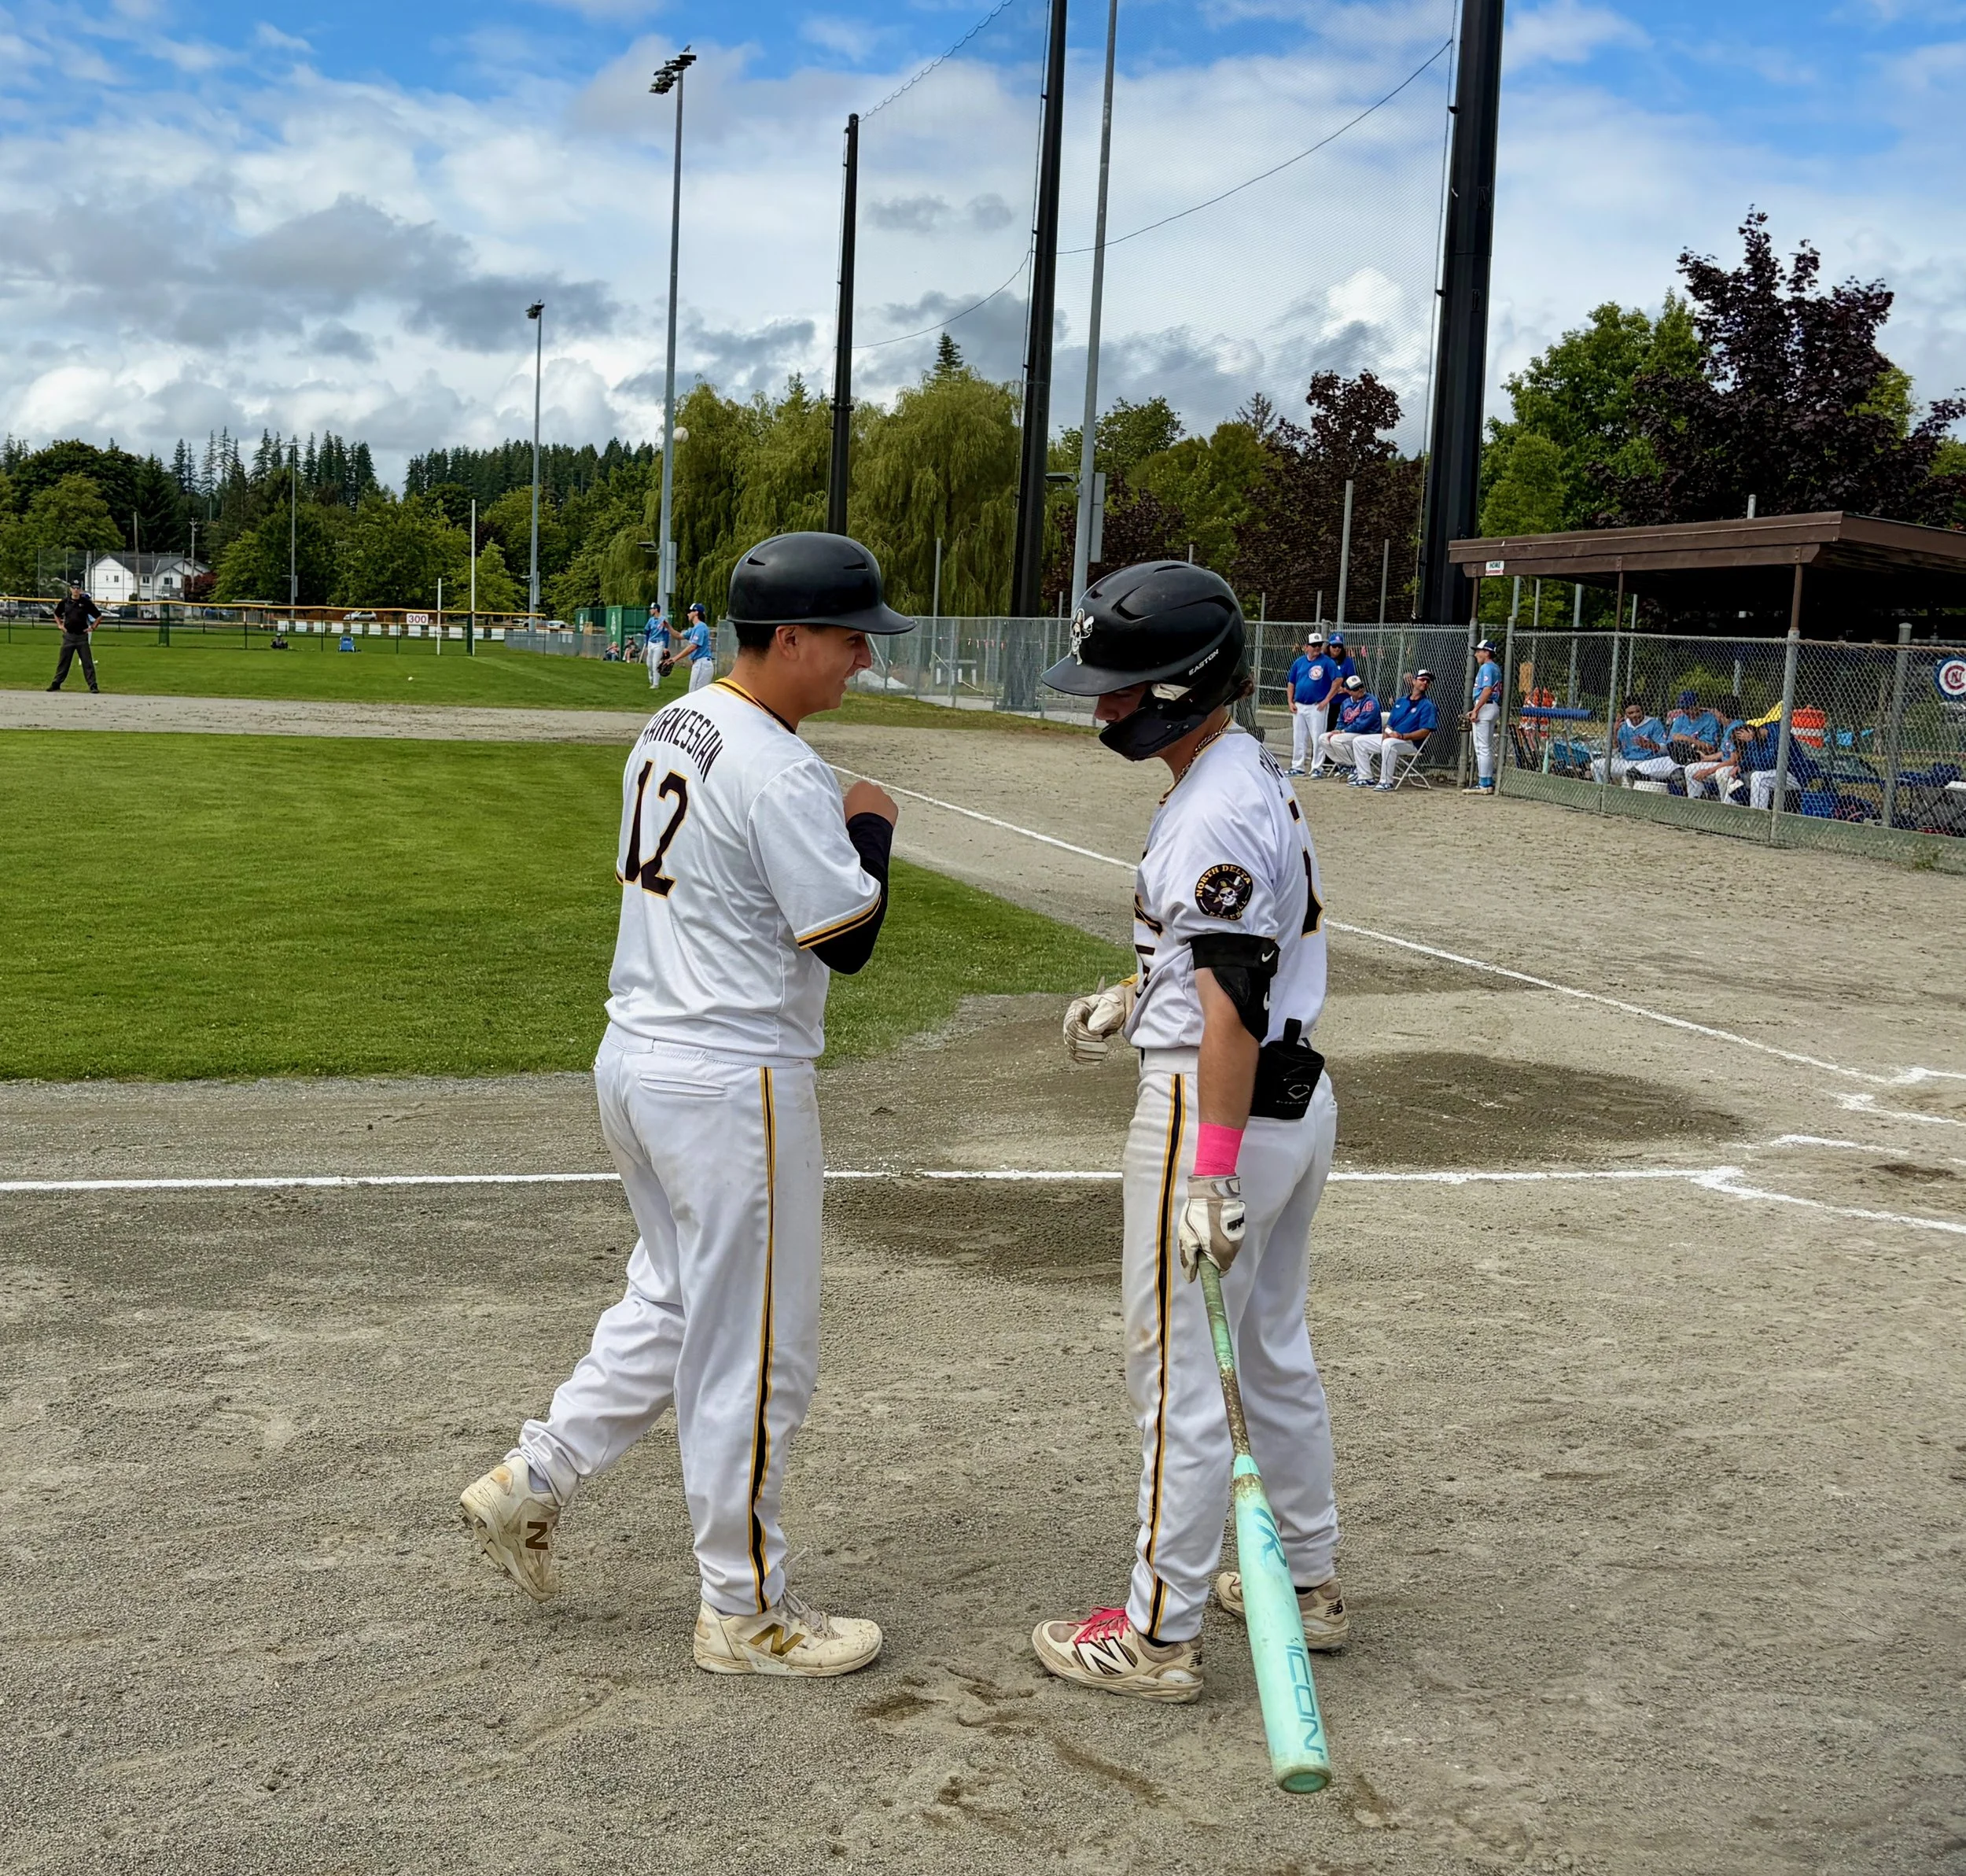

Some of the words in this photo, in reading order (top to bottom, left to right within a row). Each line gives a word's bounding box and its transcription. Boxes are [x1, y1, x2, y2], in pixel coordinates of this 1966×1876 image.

[408, 614, 427, 623] 300
[1188, 648, 1219, 676] EASTON
[624, 758, 689, 897] 12
[1195, 866, 1220, 897] NORTH
[1221, 864, 1251, 885] DELTA
[1286, 1644, 1324, 1756] ICON
